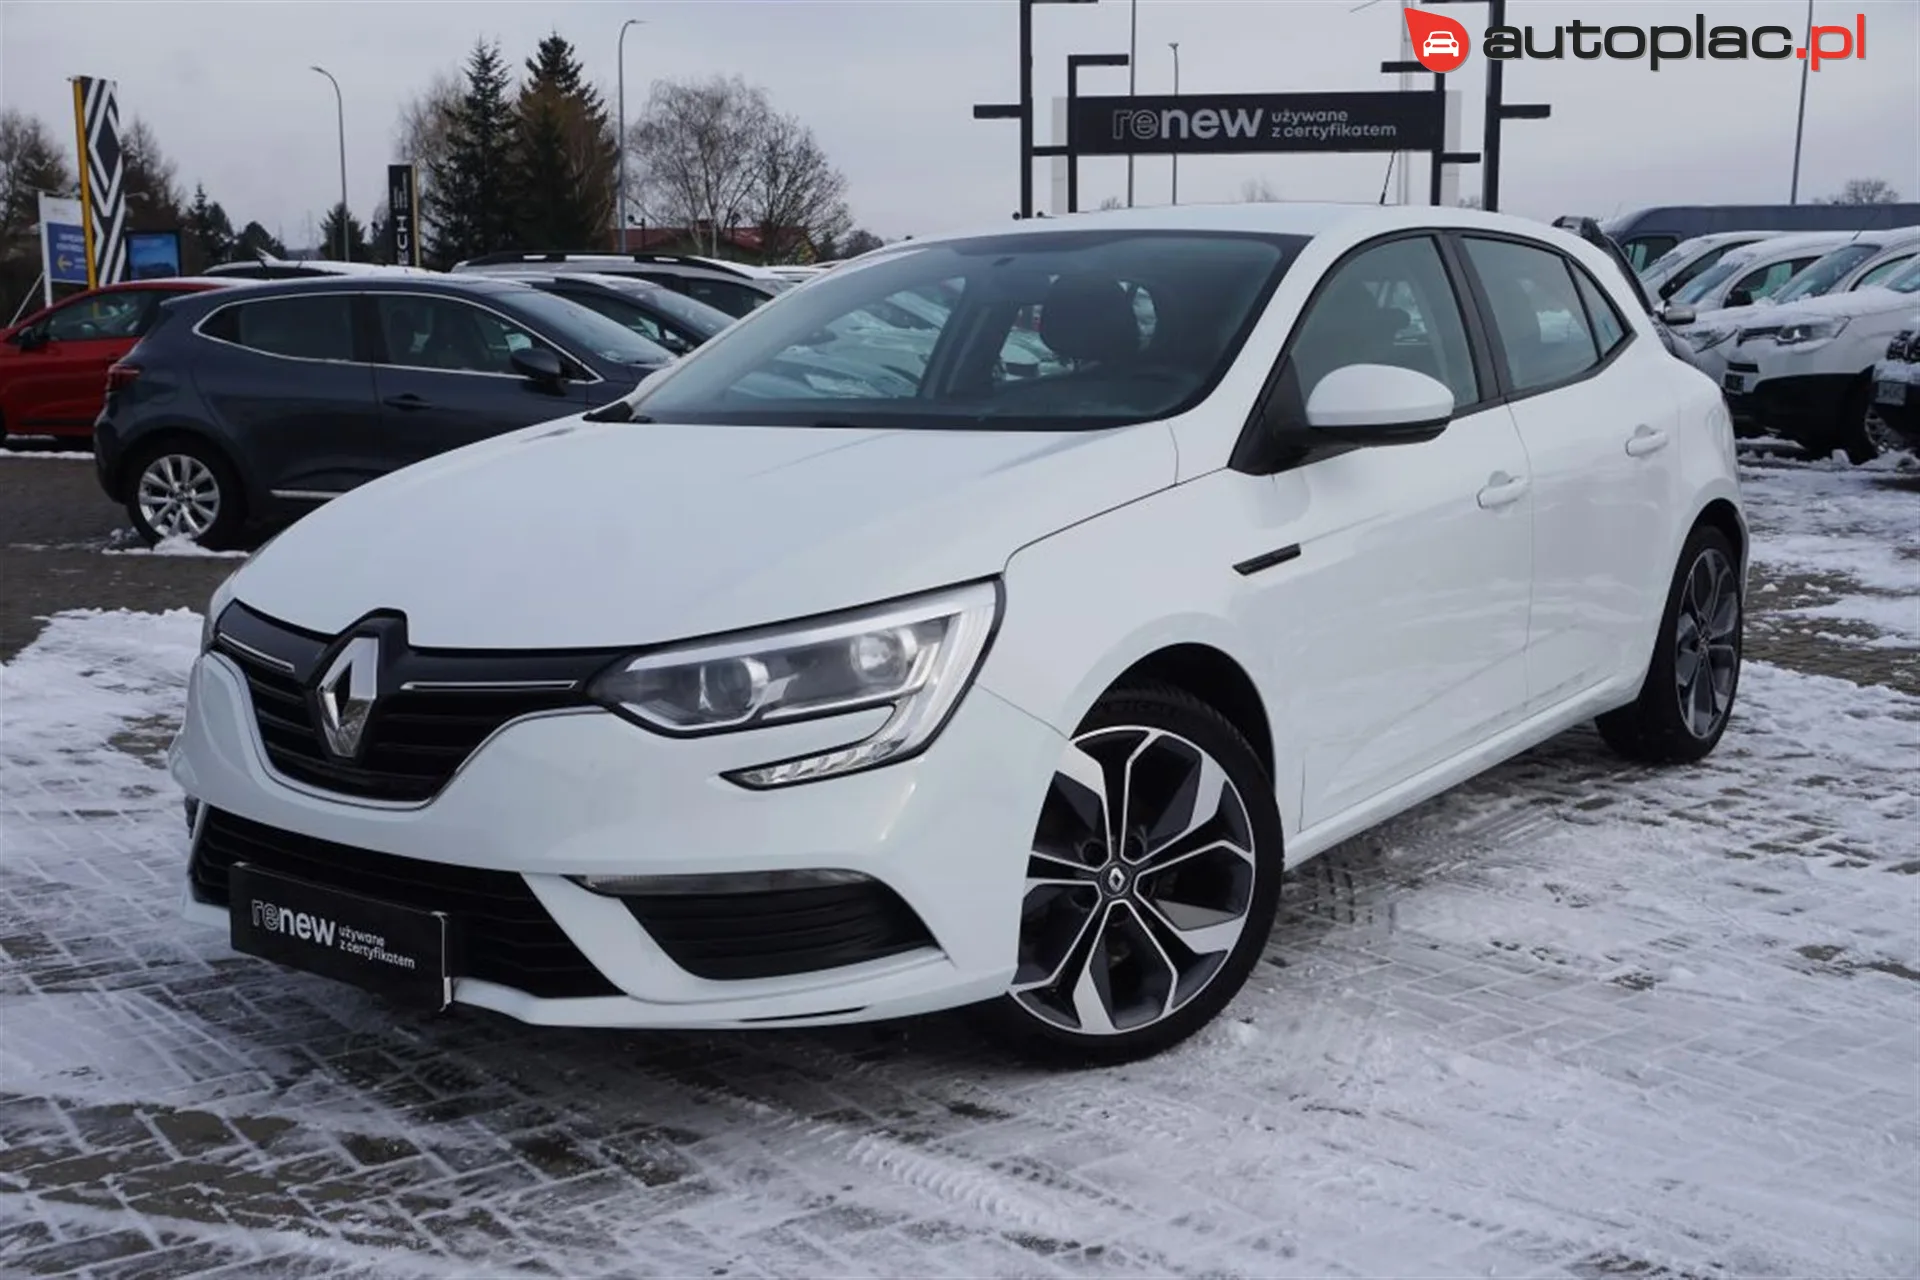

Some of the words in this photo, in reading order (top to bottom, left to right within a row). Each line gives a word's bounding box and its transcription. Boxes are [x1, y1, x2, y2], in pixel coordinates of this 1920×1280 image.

[1112, 107, 1264, 140] renew
[1271, 109, 1349, 126] używane
[1271, 129, 1281, 138] z
[1284, 123, 1397, 141] certyfikatem
[252, 899, 336, 947] renew
[338, 925, 386, 947] używane
[346, 942, 415, 970] certyfikatem
